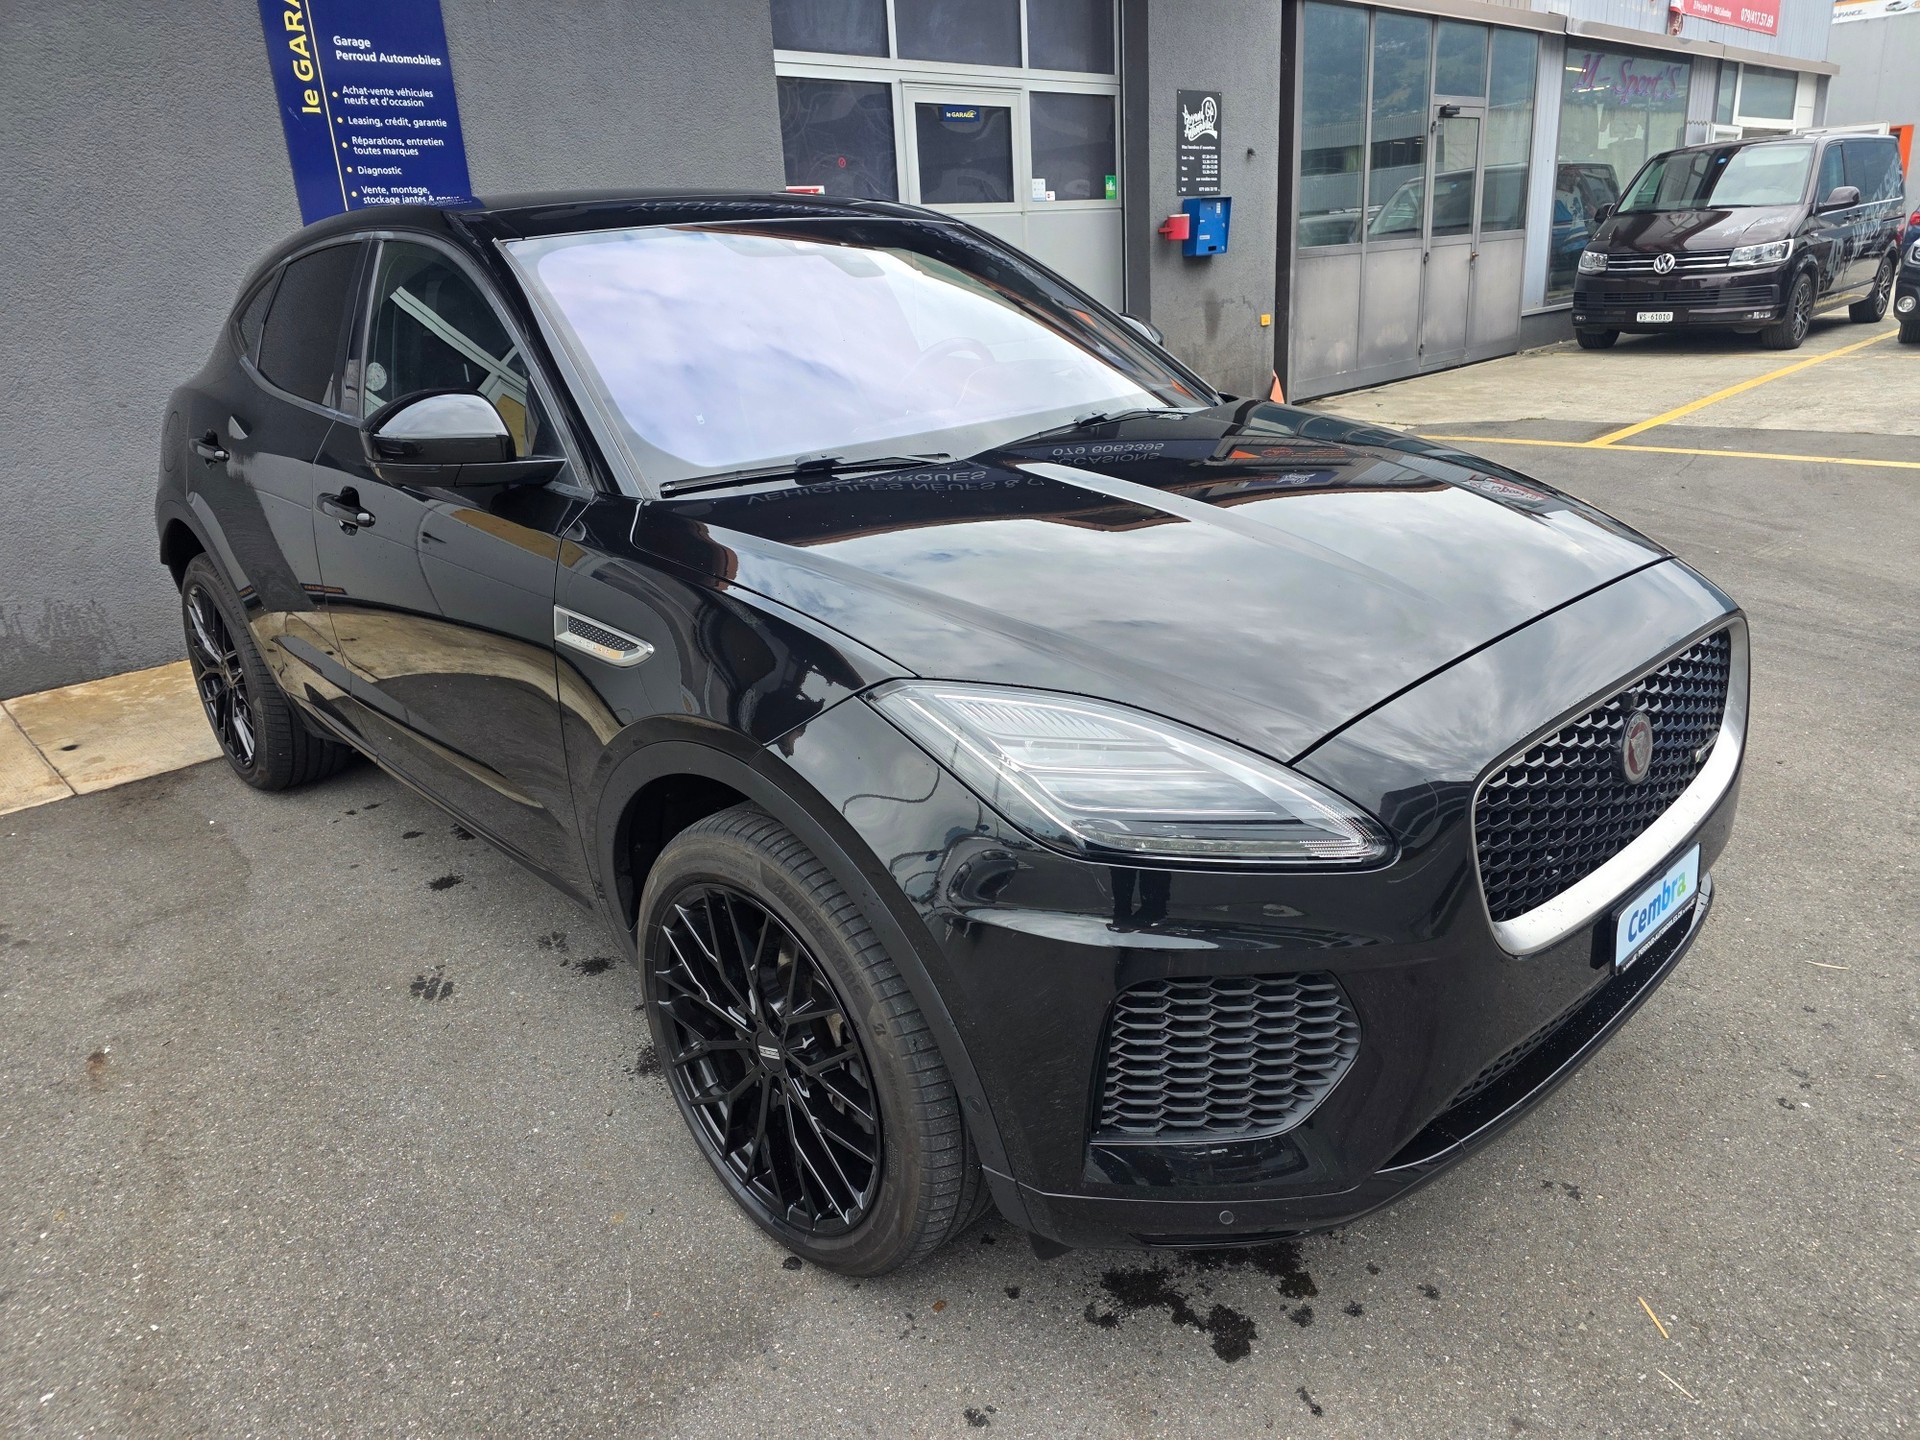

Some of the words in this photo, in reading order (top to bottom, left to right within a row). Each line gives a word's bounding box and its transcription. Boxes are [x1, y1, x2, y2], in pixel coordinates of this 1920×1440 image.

[333, 36, 371, 49] Garage
[335, 50, 377, 62] Perroud
[379, 53, 442, 66] Automobiles
[342, 86, 394, 96] Achat-vente
[396, 87, 434, 98] véhicules
[302, 89, 321, 114] le
[344, 97, 369, 106] neufs
[370, 98, 379, 106] et
[380, 98, 424, 108] d'occasion
[347, 116, 383, 128] Leasing,
[384, 117, 412, 128] crédit,
[413, 118, 448, 129] garantie
[351, 136, 405, 147] Réparations,
[406, 138, 445, 147] entretien
[353, 147, 382, 155] toutes
[382, 148, 419, 157] marques
[357, 166, 403, 177] Diagnostic
[361, 186, 389, 195] Vente,
[390, 186, 430, 195] montage,
[363, 195, 399, 205] stockage
[401, 195, 426, 205] jantes
[1651, 313, 1671, 321] 61010
[1628, 871, 1687, 943] Cembra
